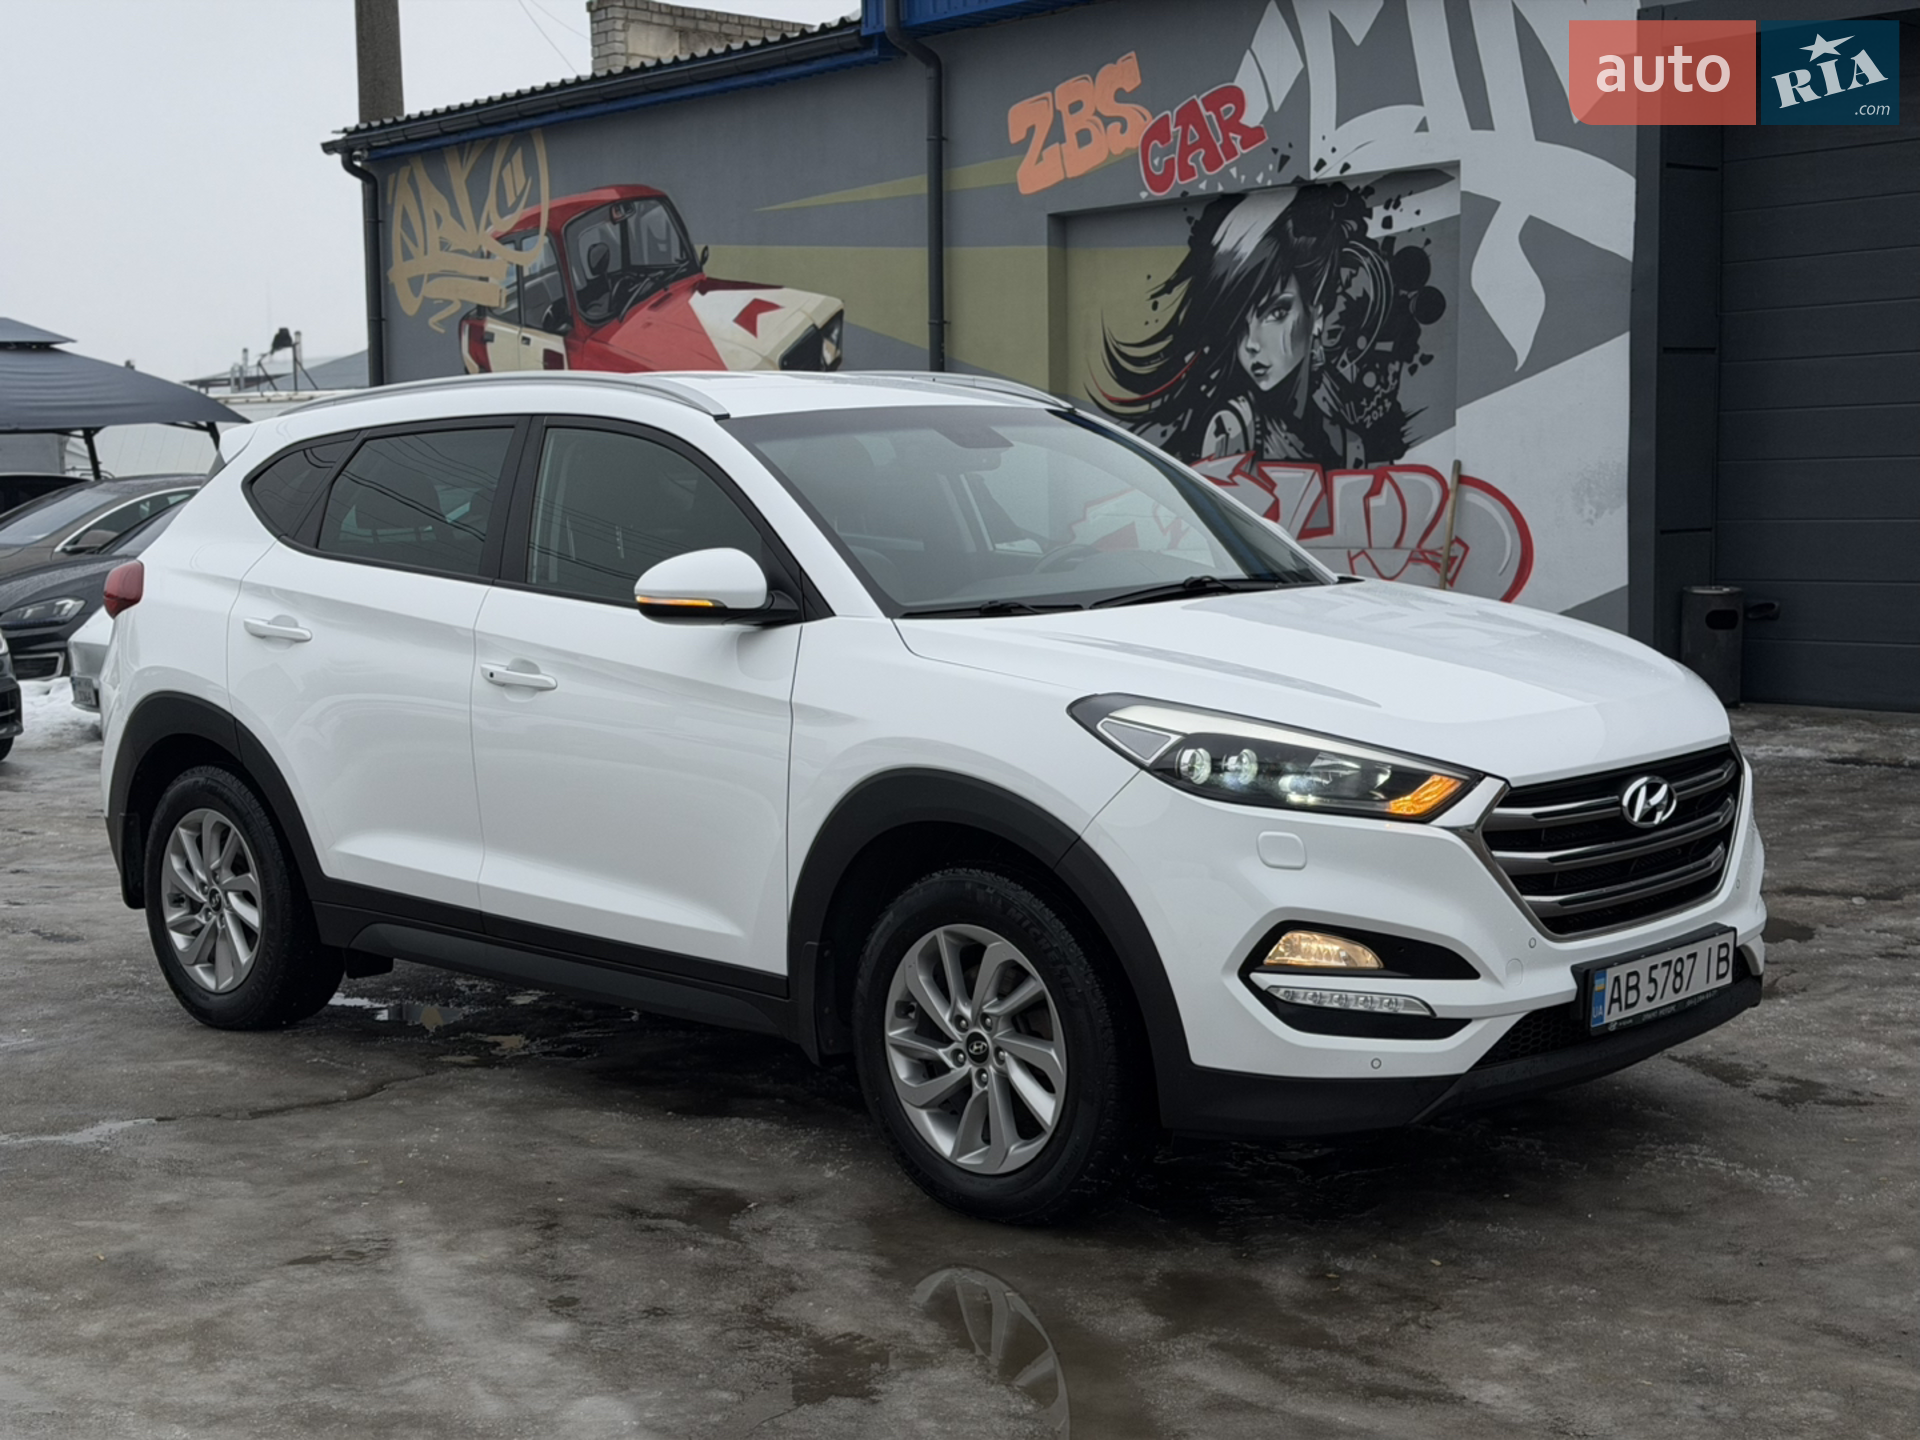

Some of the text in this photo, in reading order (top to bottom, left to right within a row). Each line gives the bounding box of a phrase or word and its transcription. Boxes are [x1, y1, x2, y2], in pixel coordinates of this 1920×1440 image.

[1008, 51, 1268, 196] ZBS CAR
[1006, 907, 1079, 1005] MICHELIN
[1607, 970, 1640, 1016] AB
[1646, 952, 1698, 1003] 5787
[1706, 942, 1730, 984] IB
